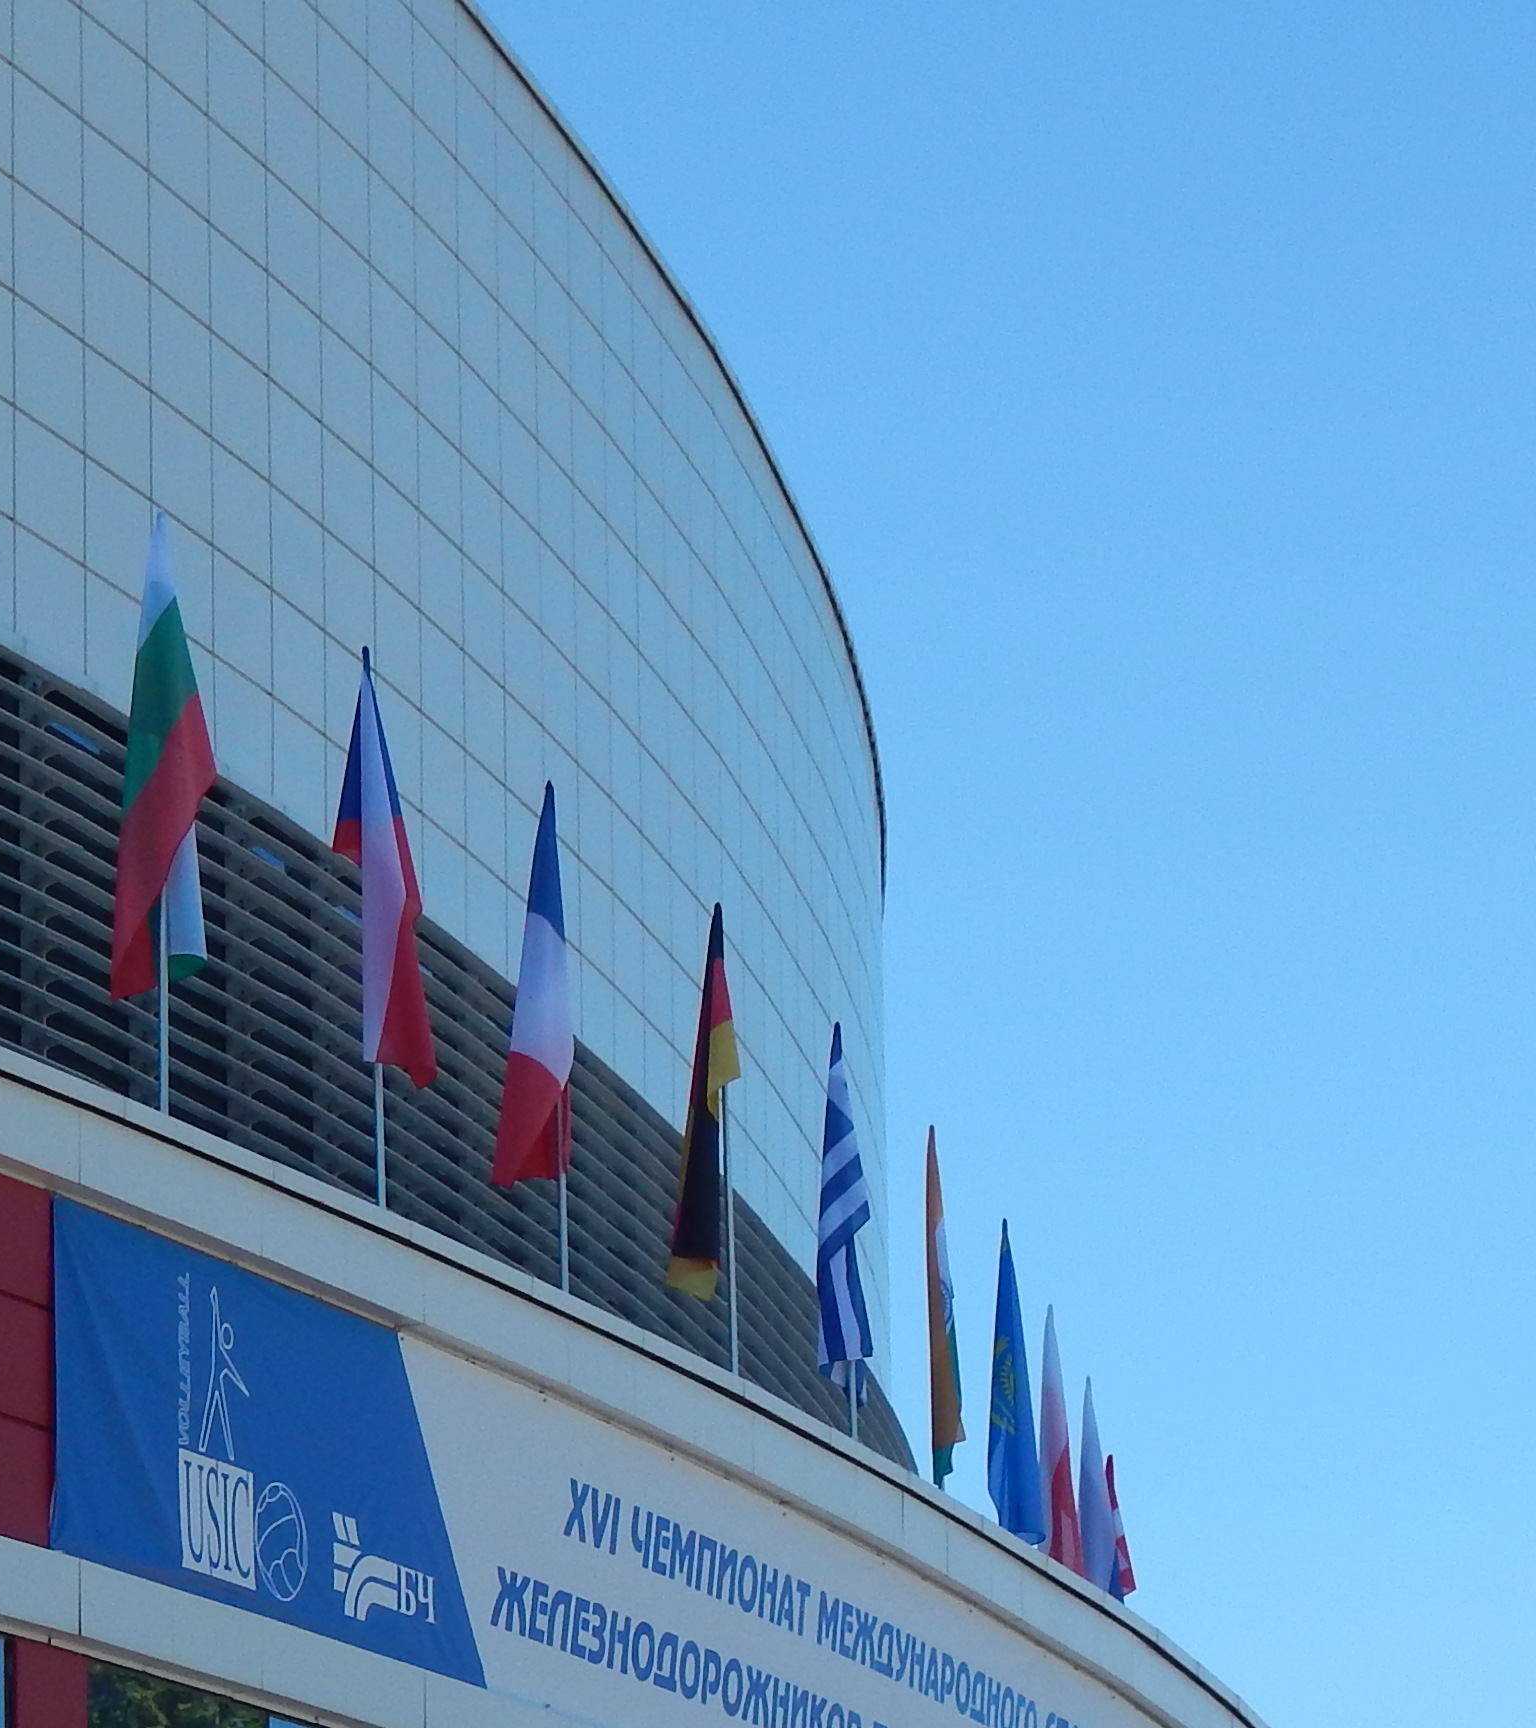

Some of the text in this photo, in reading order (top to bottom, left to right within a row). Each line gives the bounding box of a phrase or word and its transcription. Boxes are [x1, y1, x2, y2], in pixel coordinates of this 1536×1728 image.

[177, 1271, 192, 1446] VOLLEYBALL
[183, 1460, 252, 1580] USIC
[563, 1477, 621, 1555] XVI
[631, 1504, 811, 1637] ЧЕМПИОНАТ
[398, 1565, 437, 1624] БЧ
